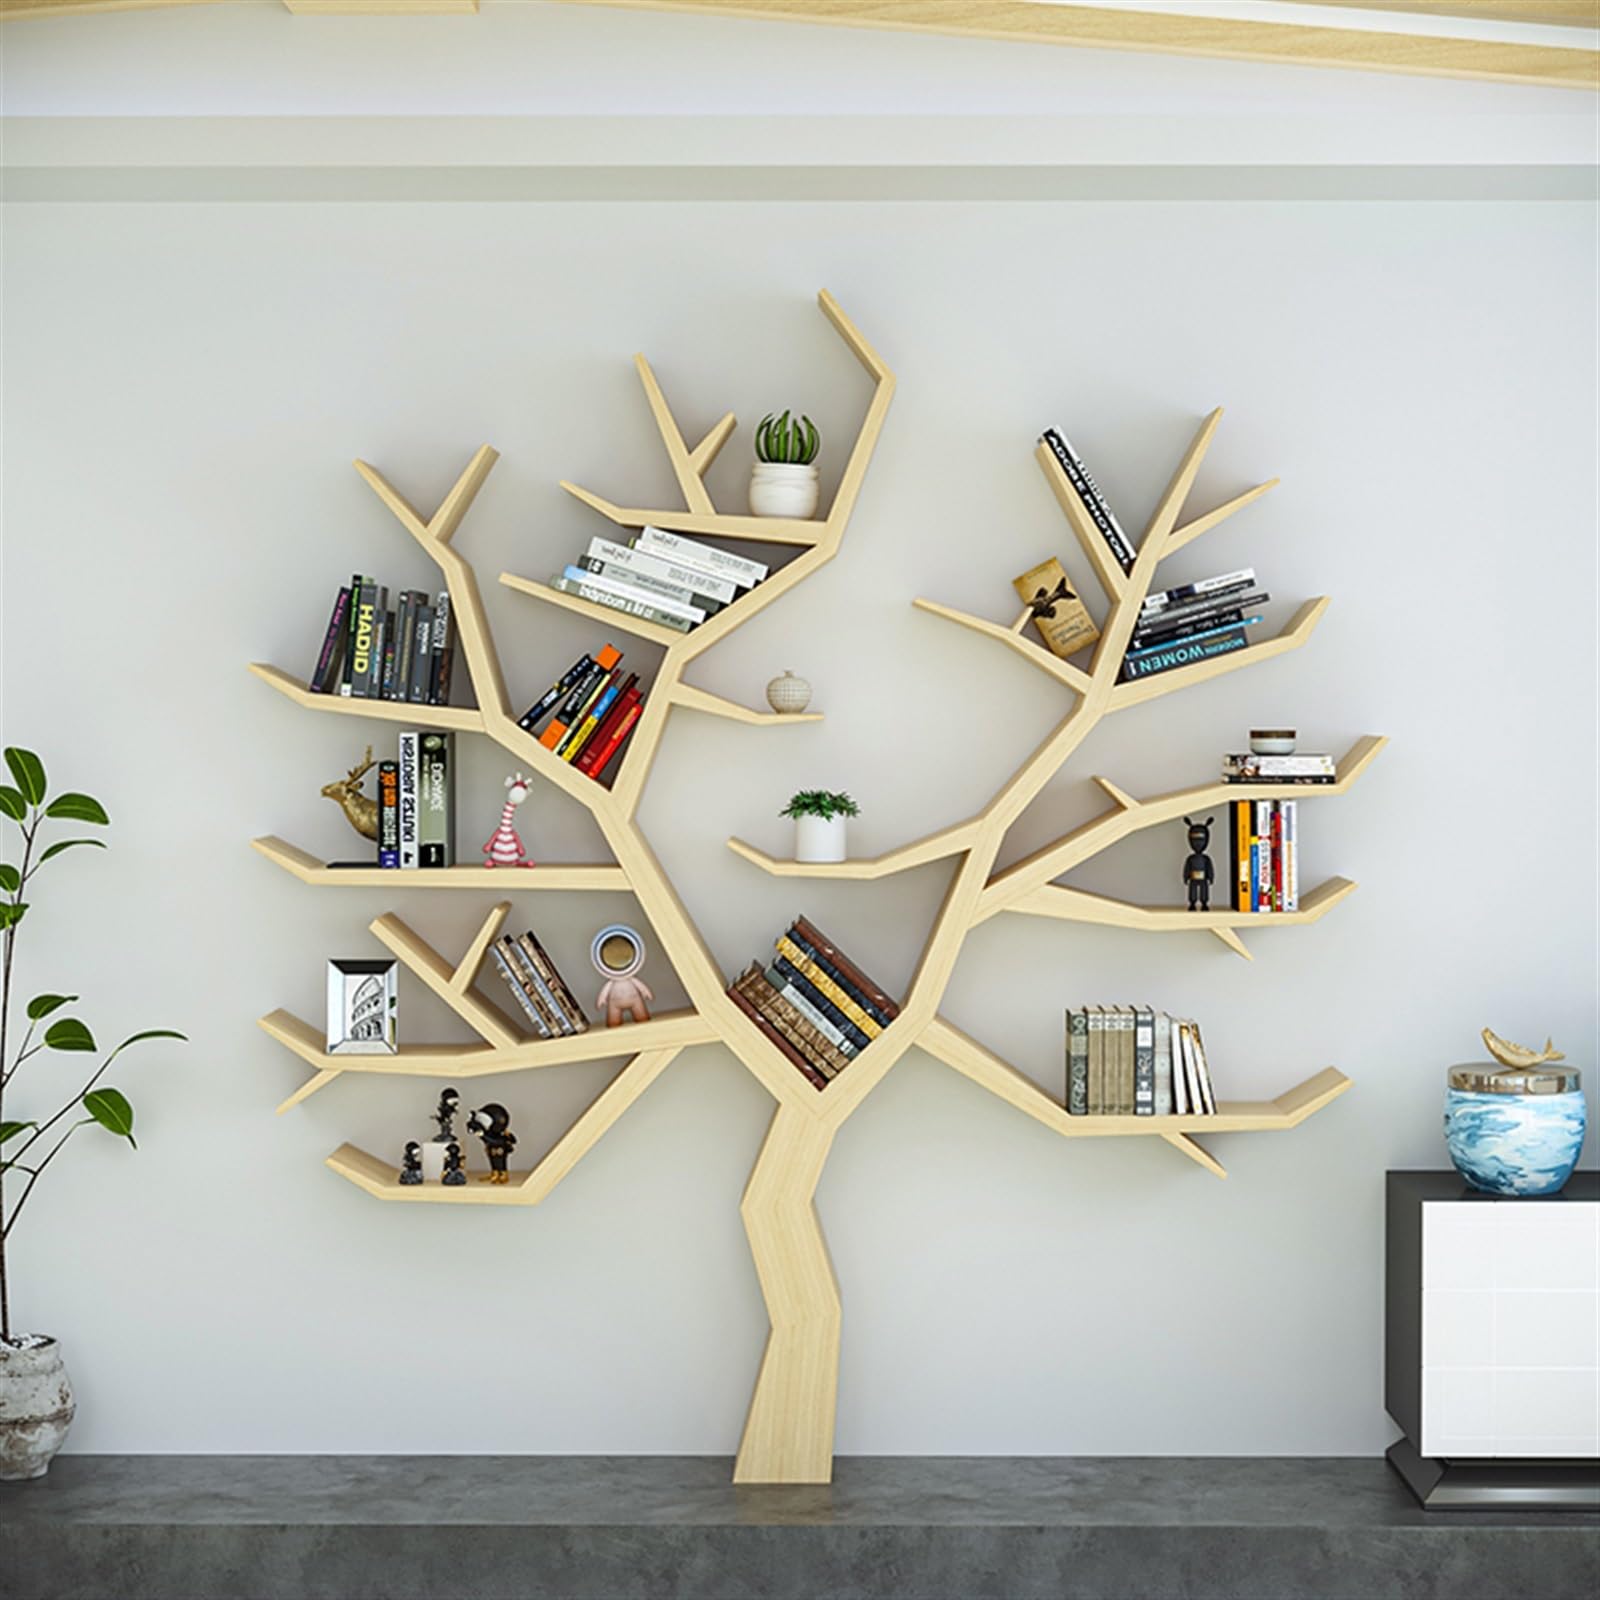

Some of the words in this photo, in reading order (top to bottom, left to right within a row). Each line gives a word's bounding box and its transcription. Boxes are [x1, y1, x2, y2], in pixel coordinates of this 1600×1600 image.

[1048, 434, 1086, 492] ADOBE
[353, 603, 374, 674] HADID
[1139, 645, 1204, 673] WOMEN
